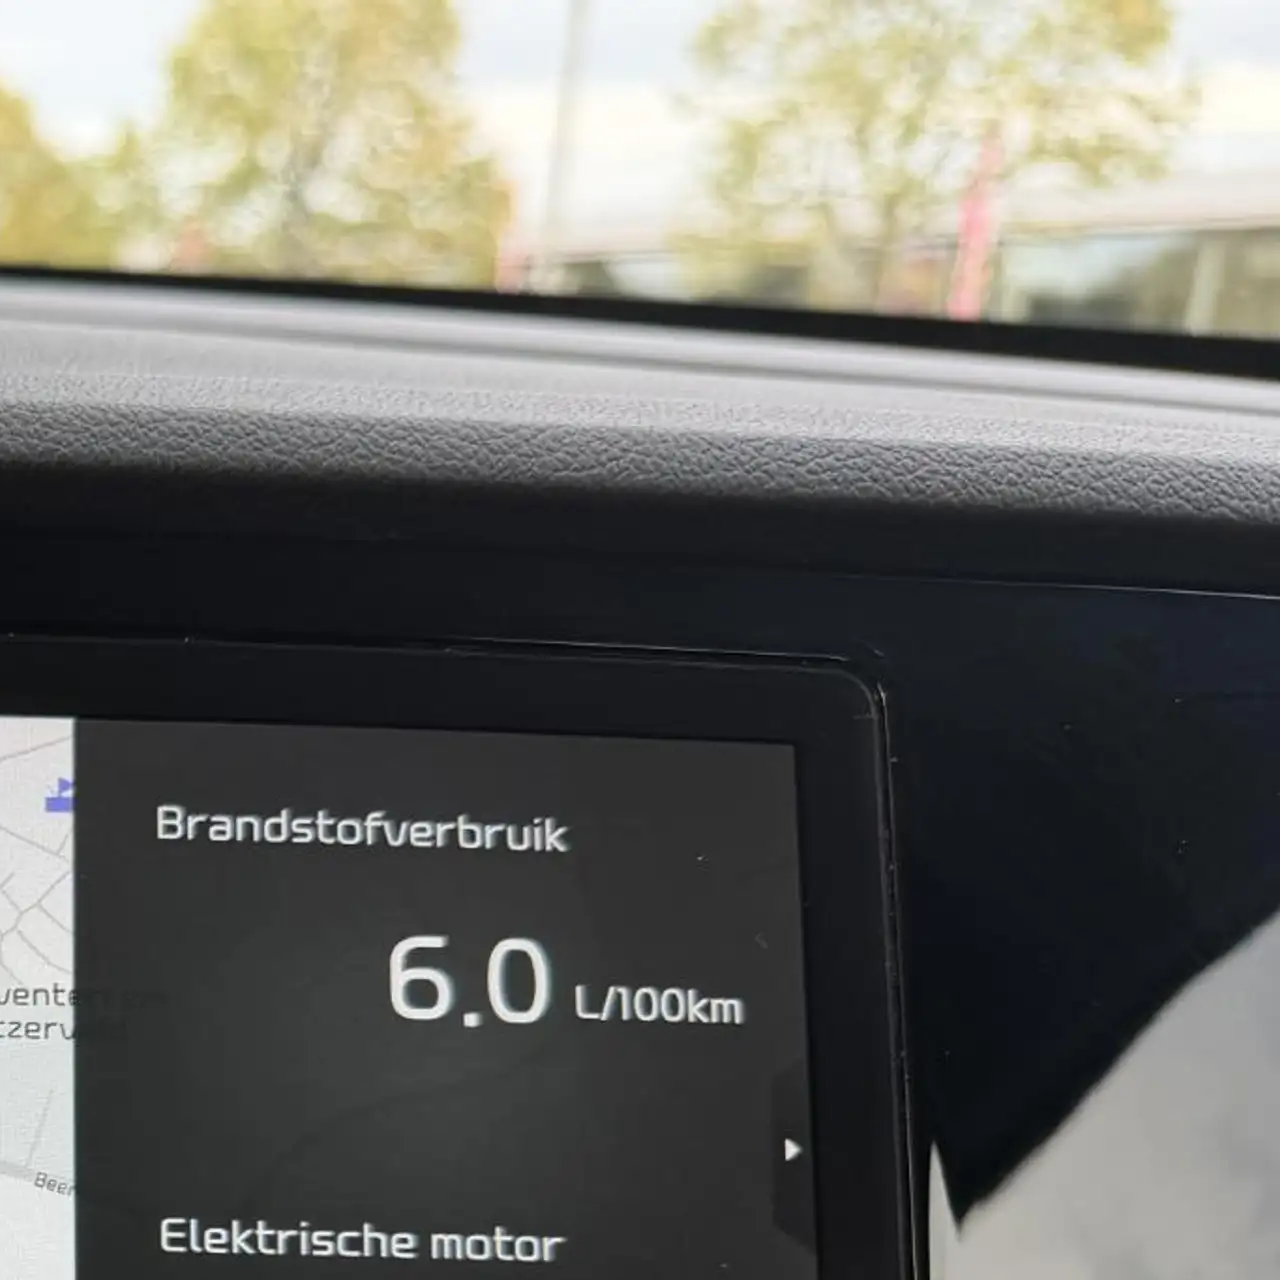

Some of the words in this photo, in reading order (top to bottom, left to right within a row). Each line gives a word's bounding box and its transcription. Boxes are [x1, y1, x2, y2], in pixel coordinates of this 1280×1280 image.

[155, 803, 569, 854] Brandstofverbruik
[388, 935, 549, 1028] 6.0
[575, 984, 745, 1026] L/100km
[159, 1217, 419, 1259] Elektrische
[431, 1226, 567, 1263] motor
